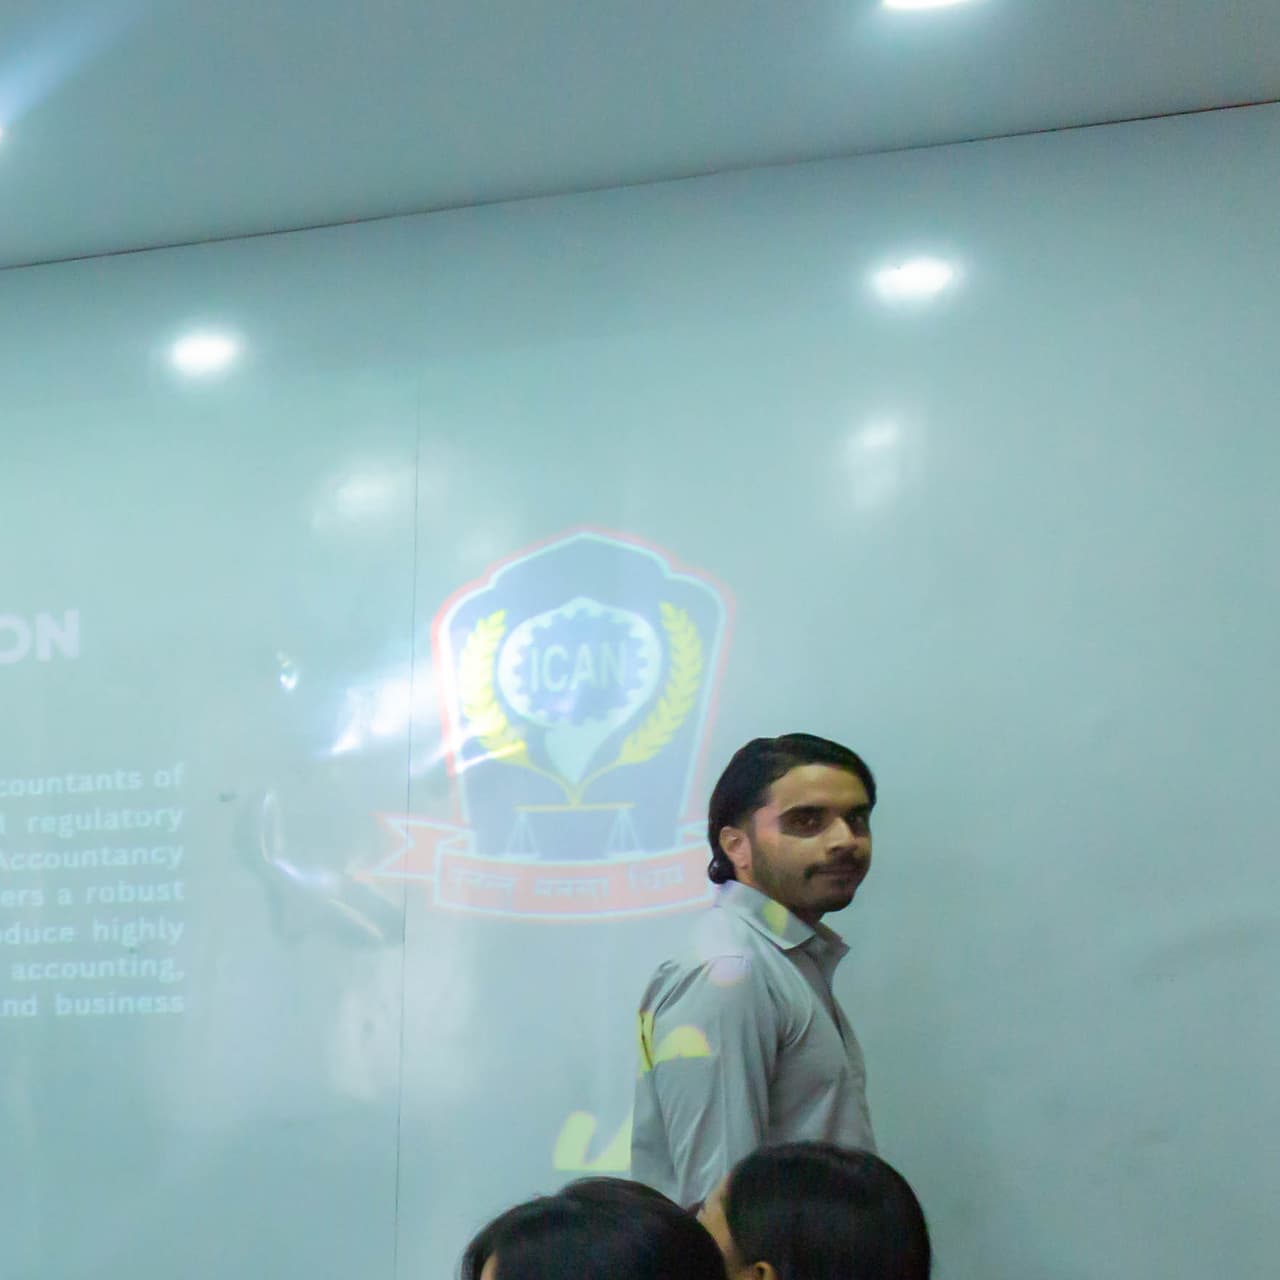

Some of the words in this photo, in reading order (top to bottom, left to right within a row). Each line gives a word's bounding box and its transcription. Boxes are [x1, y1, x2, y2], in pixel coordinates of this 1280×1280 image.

[530, 642, 625, 691] ICAN
[153, 762, 183, 788] of
[27, 807, 184, 838] regulatory
[58, 888, 71, 905] a
[87, 880, 183, 903] robust
[93, 916, 183, 946] highly
[55, 991, 183, 1016] business
